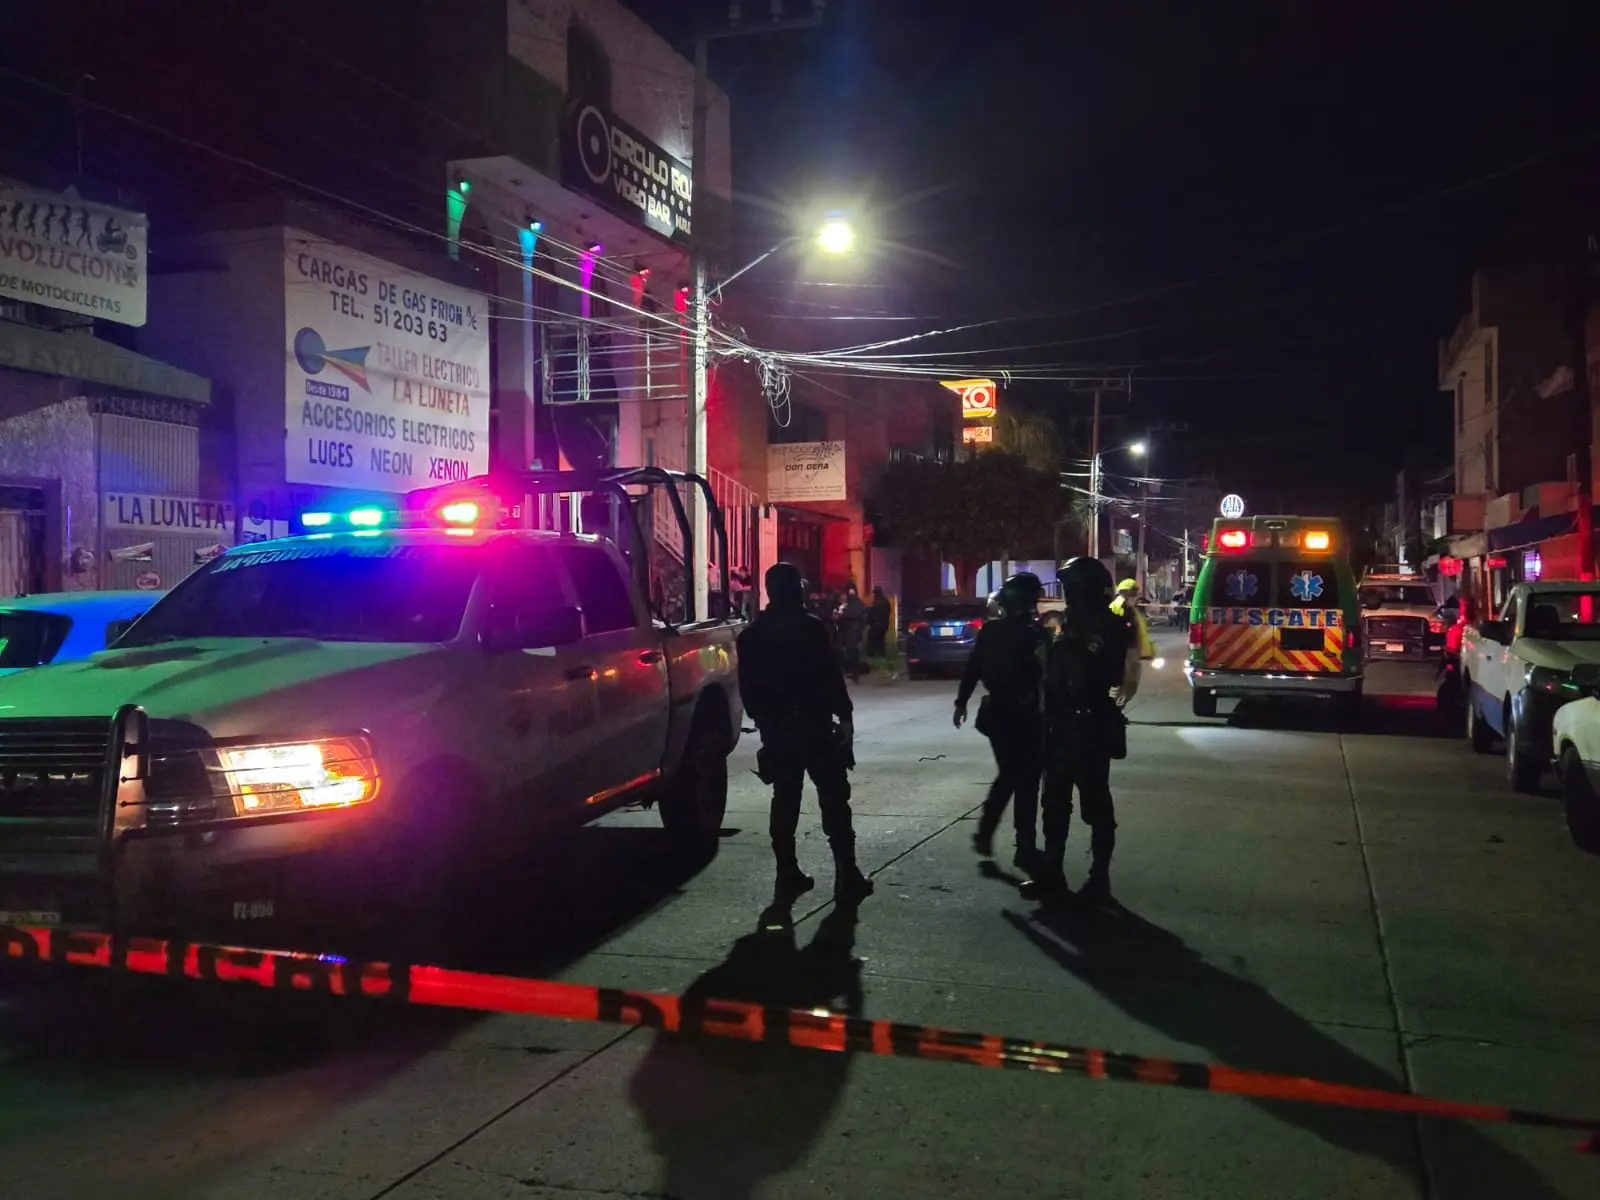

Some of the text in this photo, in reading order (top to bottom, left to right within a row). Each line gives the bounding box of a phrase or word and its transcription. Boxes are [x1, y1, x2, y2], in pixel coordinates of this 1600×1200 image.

[611, 125, 669, 187] CIRCULO
[612, 172, 646, 211] VIDEO
[647, 194, 671, 226] BAR
[22, 279, 121, 314] MOTOCICLETAS
[297, 253, 369, 296] CARGAS
[379, 280, 397, 302] DE
[402, 289, 426, 315] GAS
[430, 297, 462, 327] FRION
[329, 290, 364, 320] TEL.
[377, 341, 480, 389] TALLER ELECTRICO
[394, 377, 470, 417] LA LUNETA
[301, 400, 476, 453] ACCESORIOS ELECTRICOS
[308, 437, 469, 481] LUCES NEON XENON
[1211, 607, 1340, 628] RESCATE
